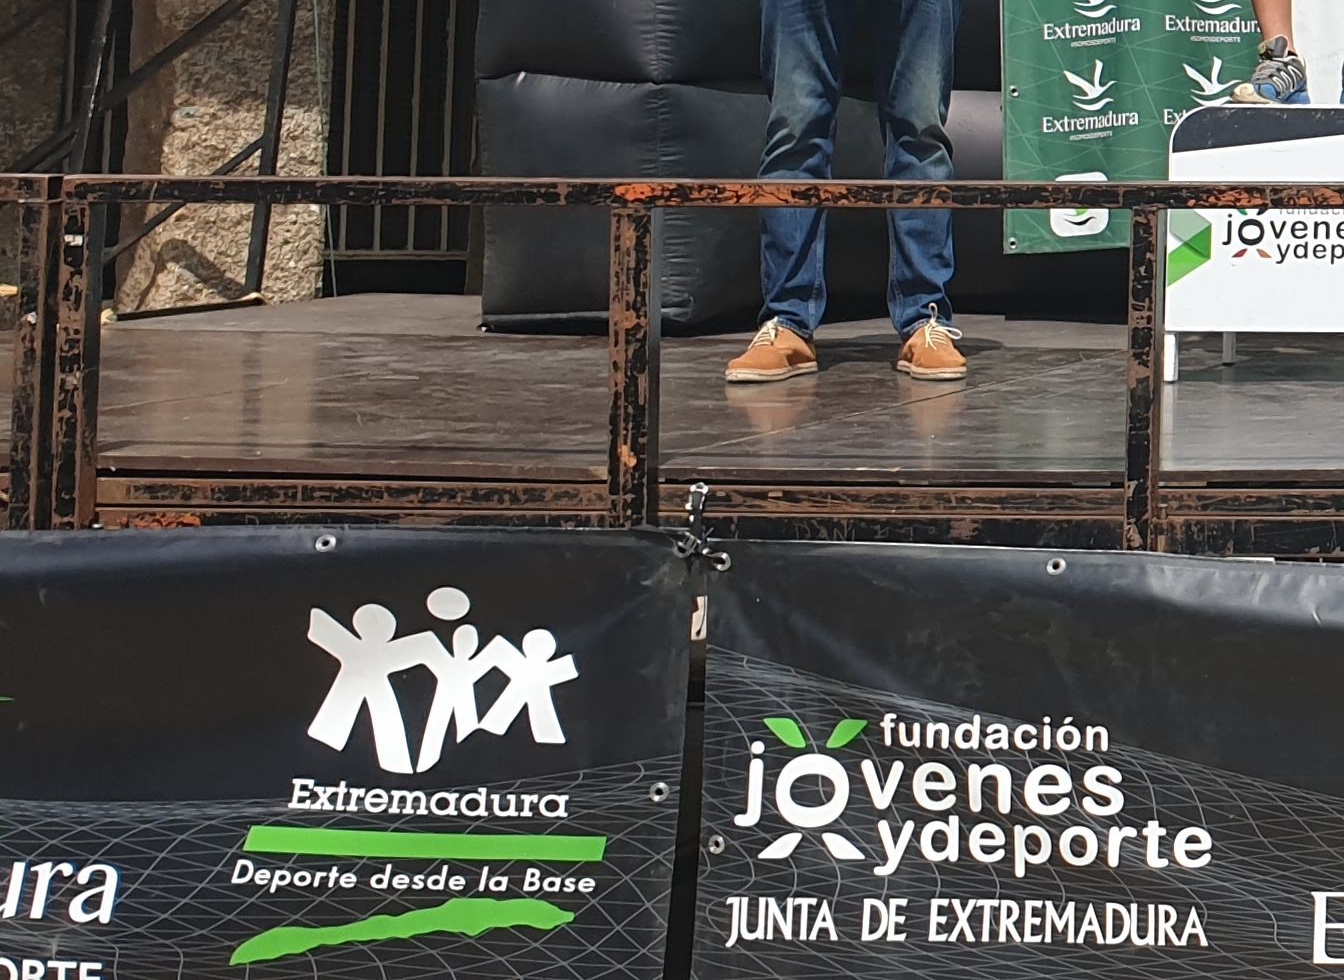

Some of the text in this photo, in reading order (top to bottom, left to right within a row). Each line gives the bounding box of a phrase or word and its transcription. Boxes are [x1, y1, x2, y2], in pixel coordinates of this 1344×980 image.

[1044, 17, 1141, 40] Extremadura
[1042, 110, 1139, 134] Extremadura
[879, 711, 1110, 752] fundación
[288, 777, 569, 819] Extremadura
[872, 814, 1213, 878] ydeporte
[231, 859, 596, 896] Deporte desde la Base
[725, 895, 1209, 948] JUNTA DE EXTREMADURA
